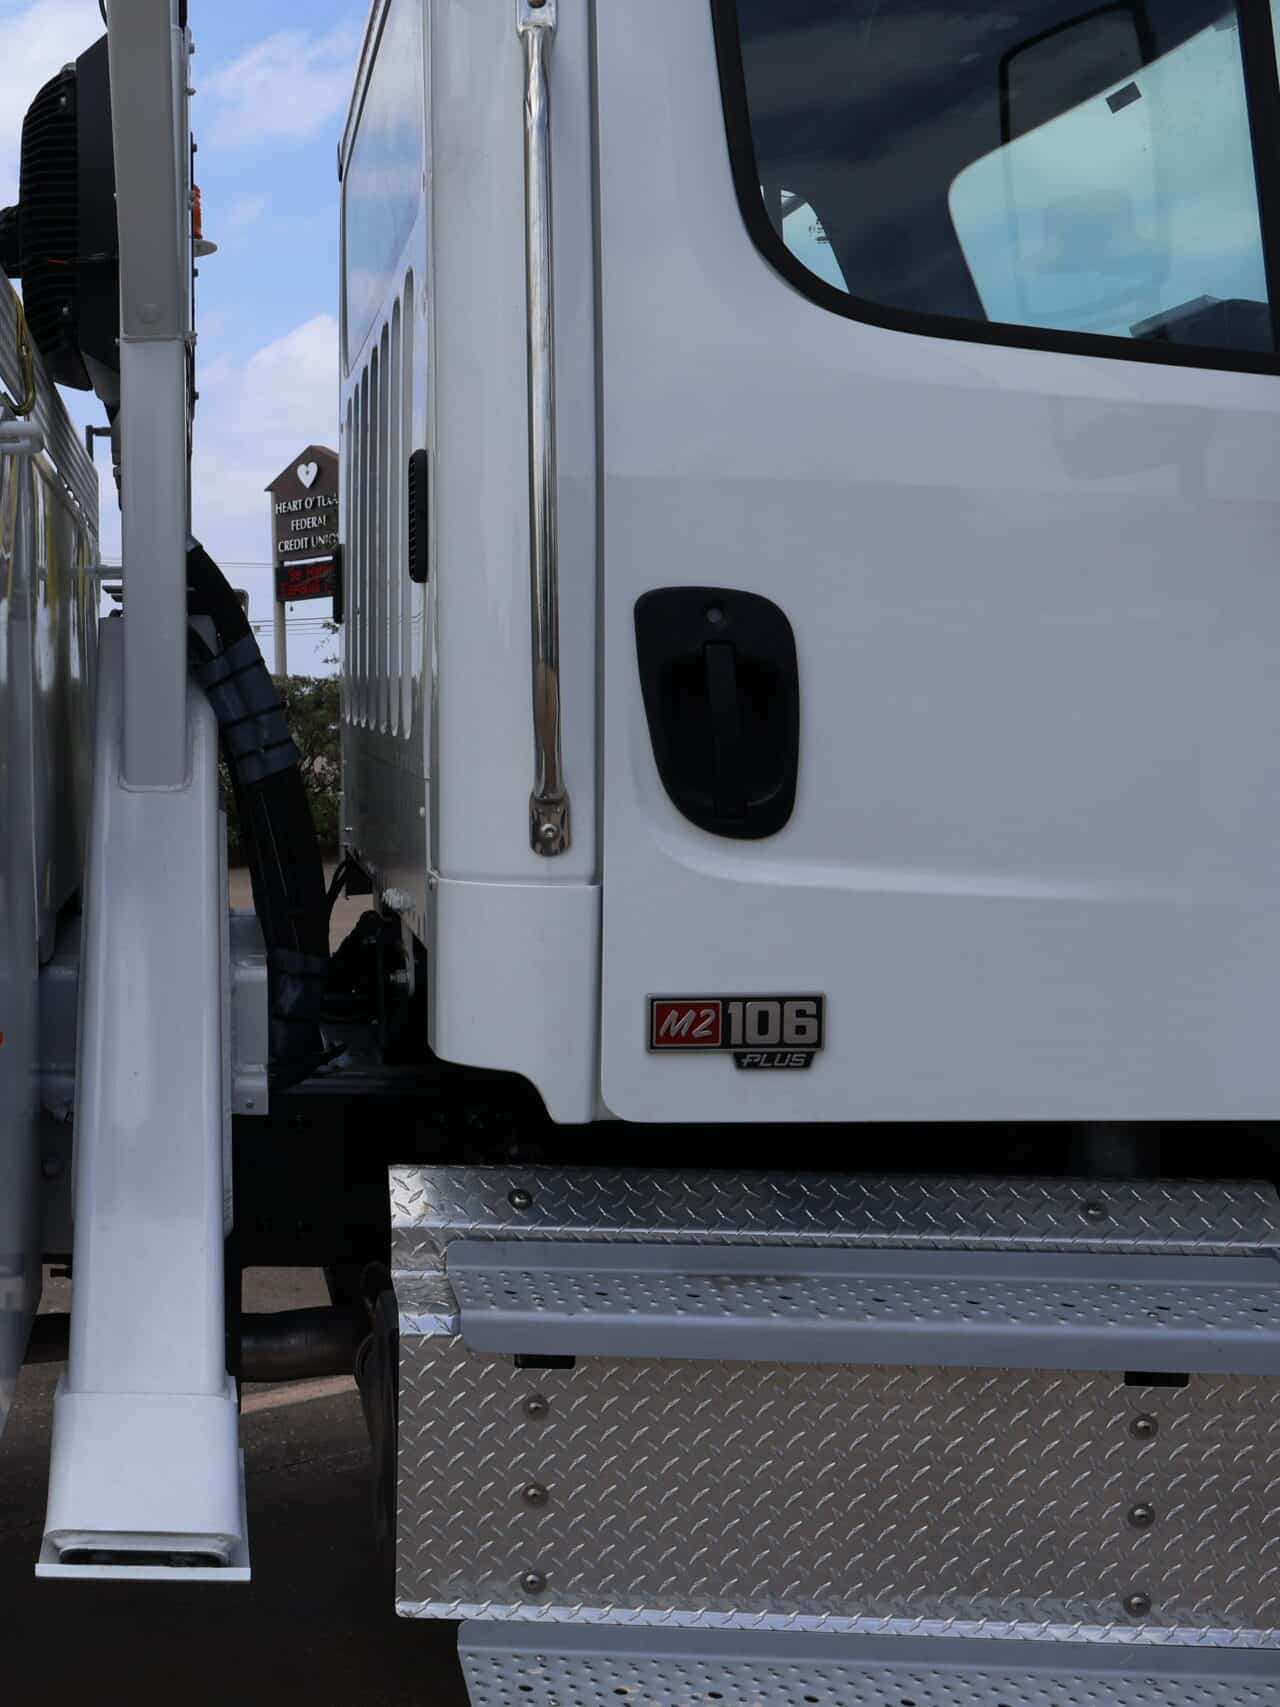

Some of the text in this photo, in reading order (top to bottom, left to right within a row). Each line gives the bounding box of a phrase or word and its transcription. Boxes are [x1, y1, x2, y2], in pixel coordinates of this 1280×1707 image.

[275, 499, 302, 514] HEART
[278, 532, 339, 553] CREDIT UNIO
[659, 1001, 819, 1045] M2 106
